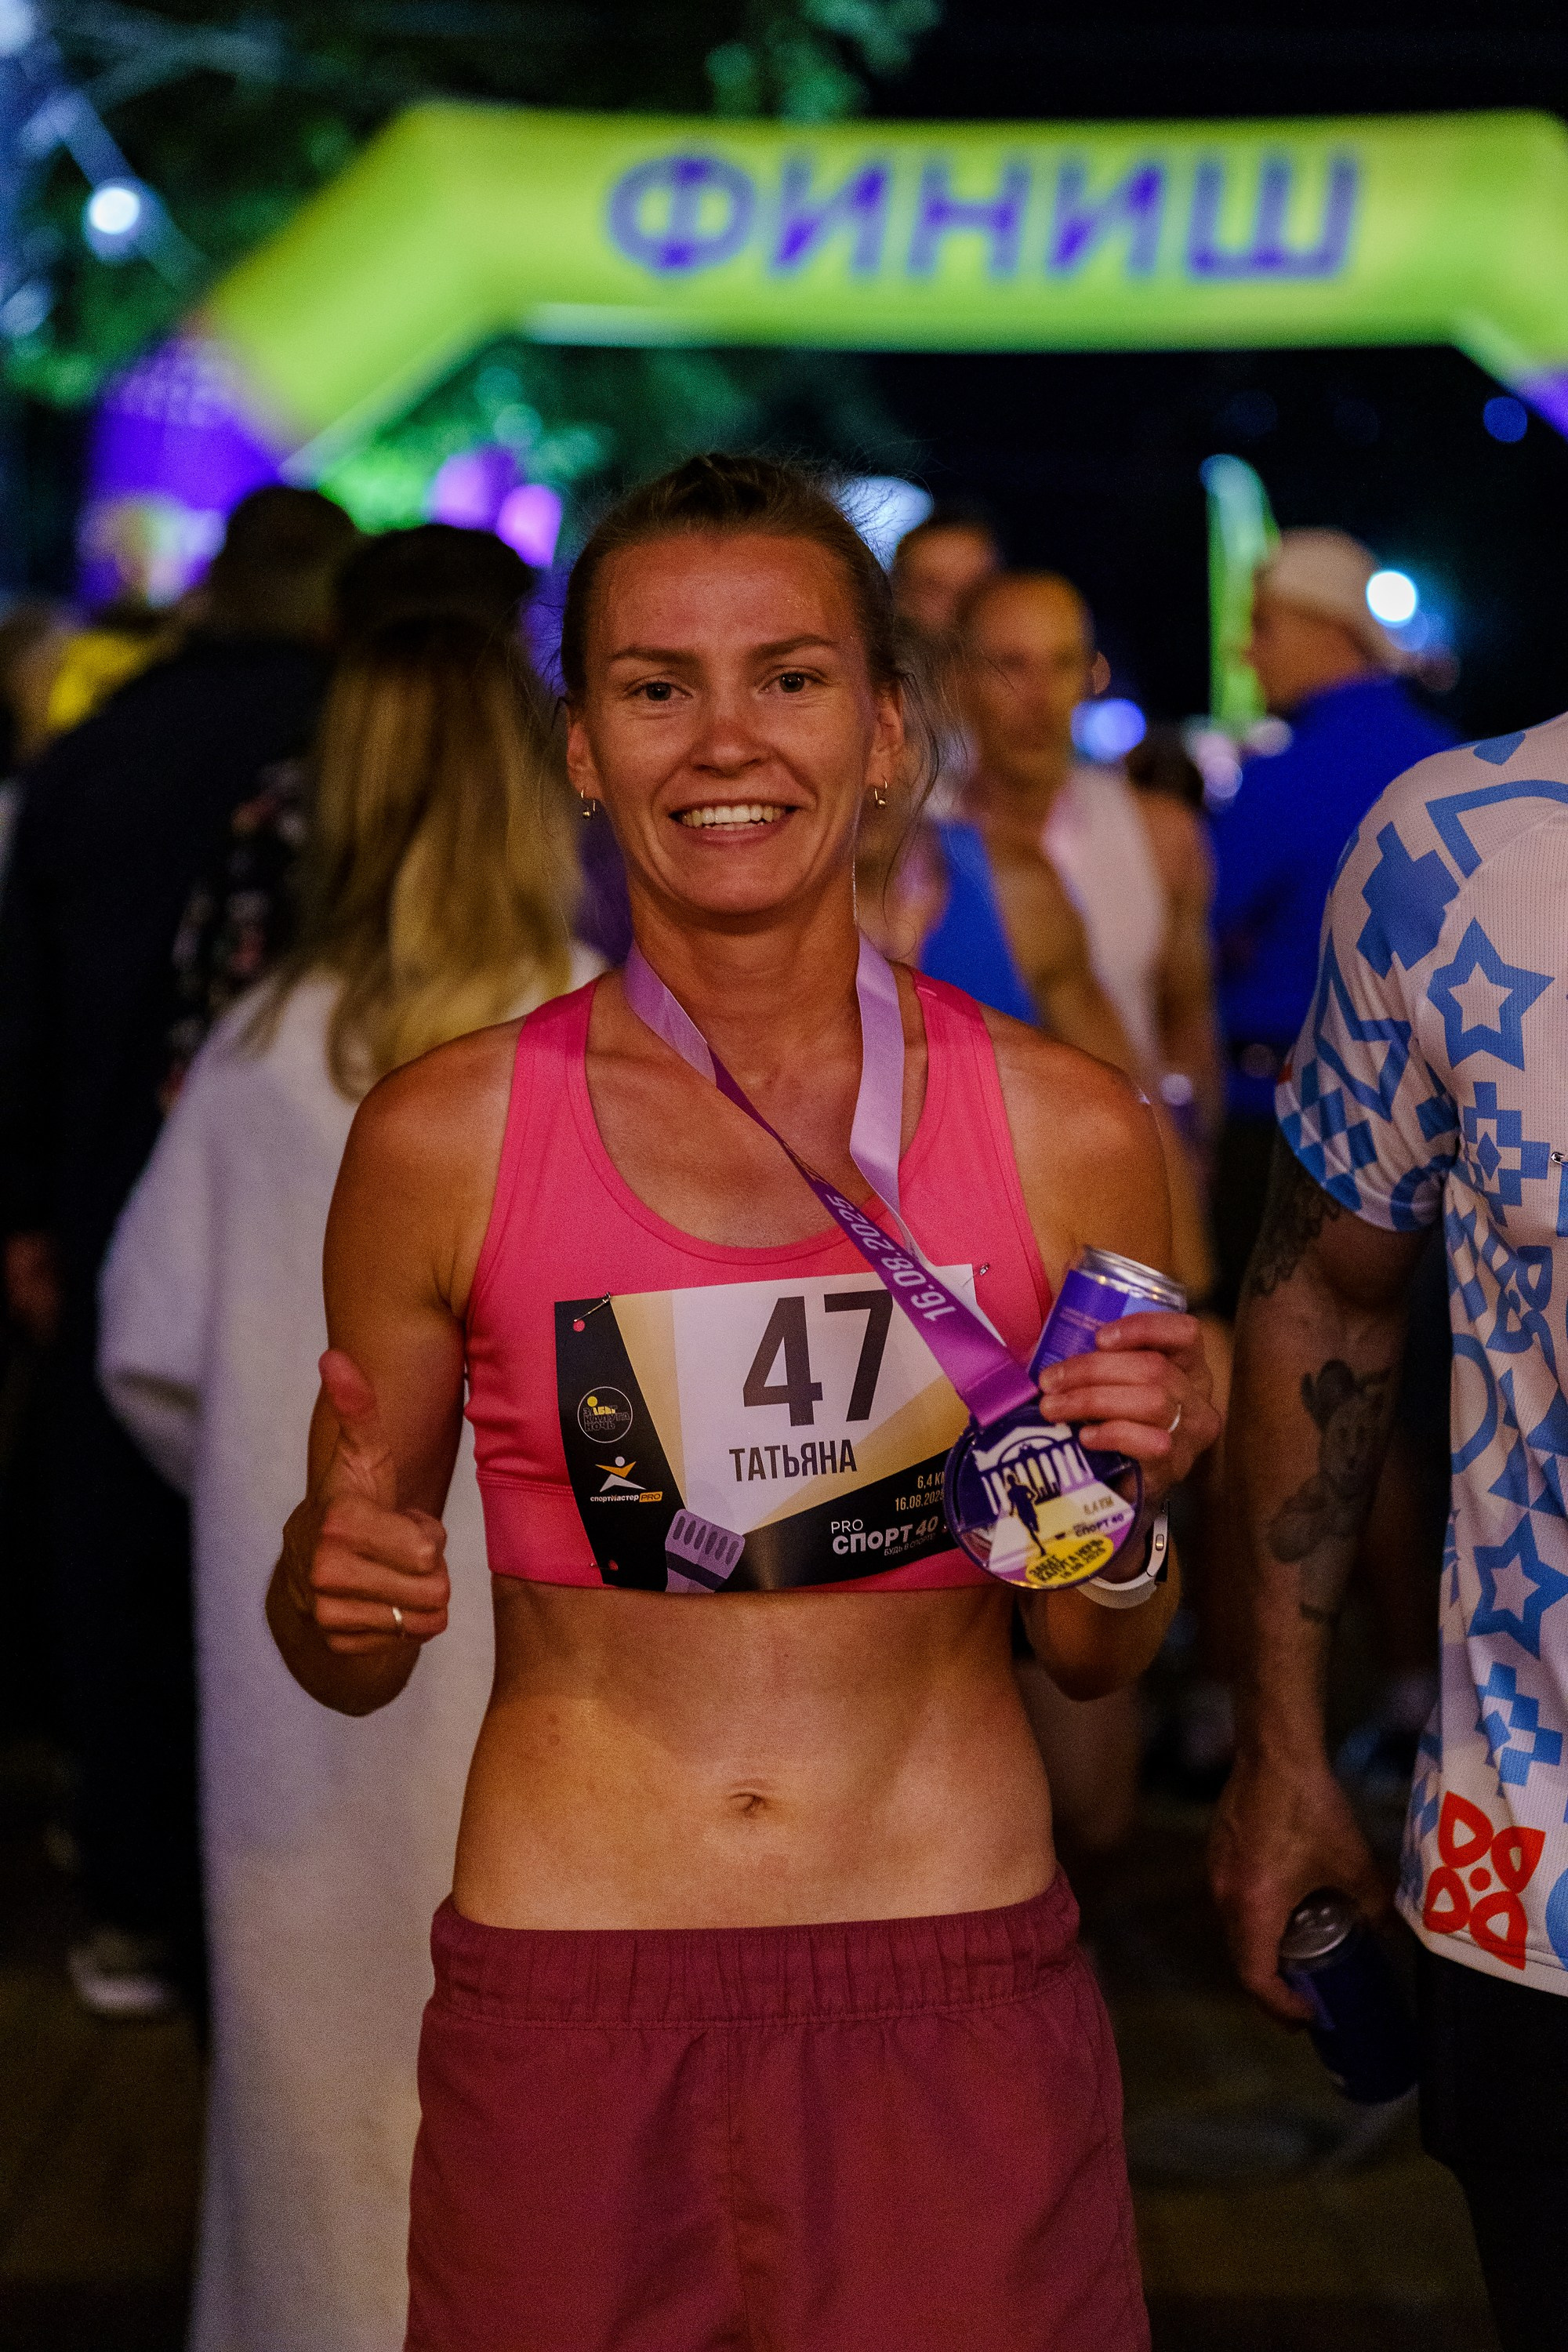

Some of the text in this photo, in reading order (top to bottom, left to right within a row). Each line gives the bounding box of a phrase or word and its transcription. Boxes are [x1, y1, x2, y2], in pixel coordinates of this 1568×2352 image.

[608, 149, 1362, 281] ФИНИШ
[826, 1193, 957, 1321] 16.08.2025
[742, 1288, 894, 1427] 47
[729, 1439, 858, 1482] ТАТЬЯНА
[917, 1474, 932, 1489] 6,4
[831, 1519, 863, 1534] PRO
[833, 1515, 938, 1555] СПОРТ 40
